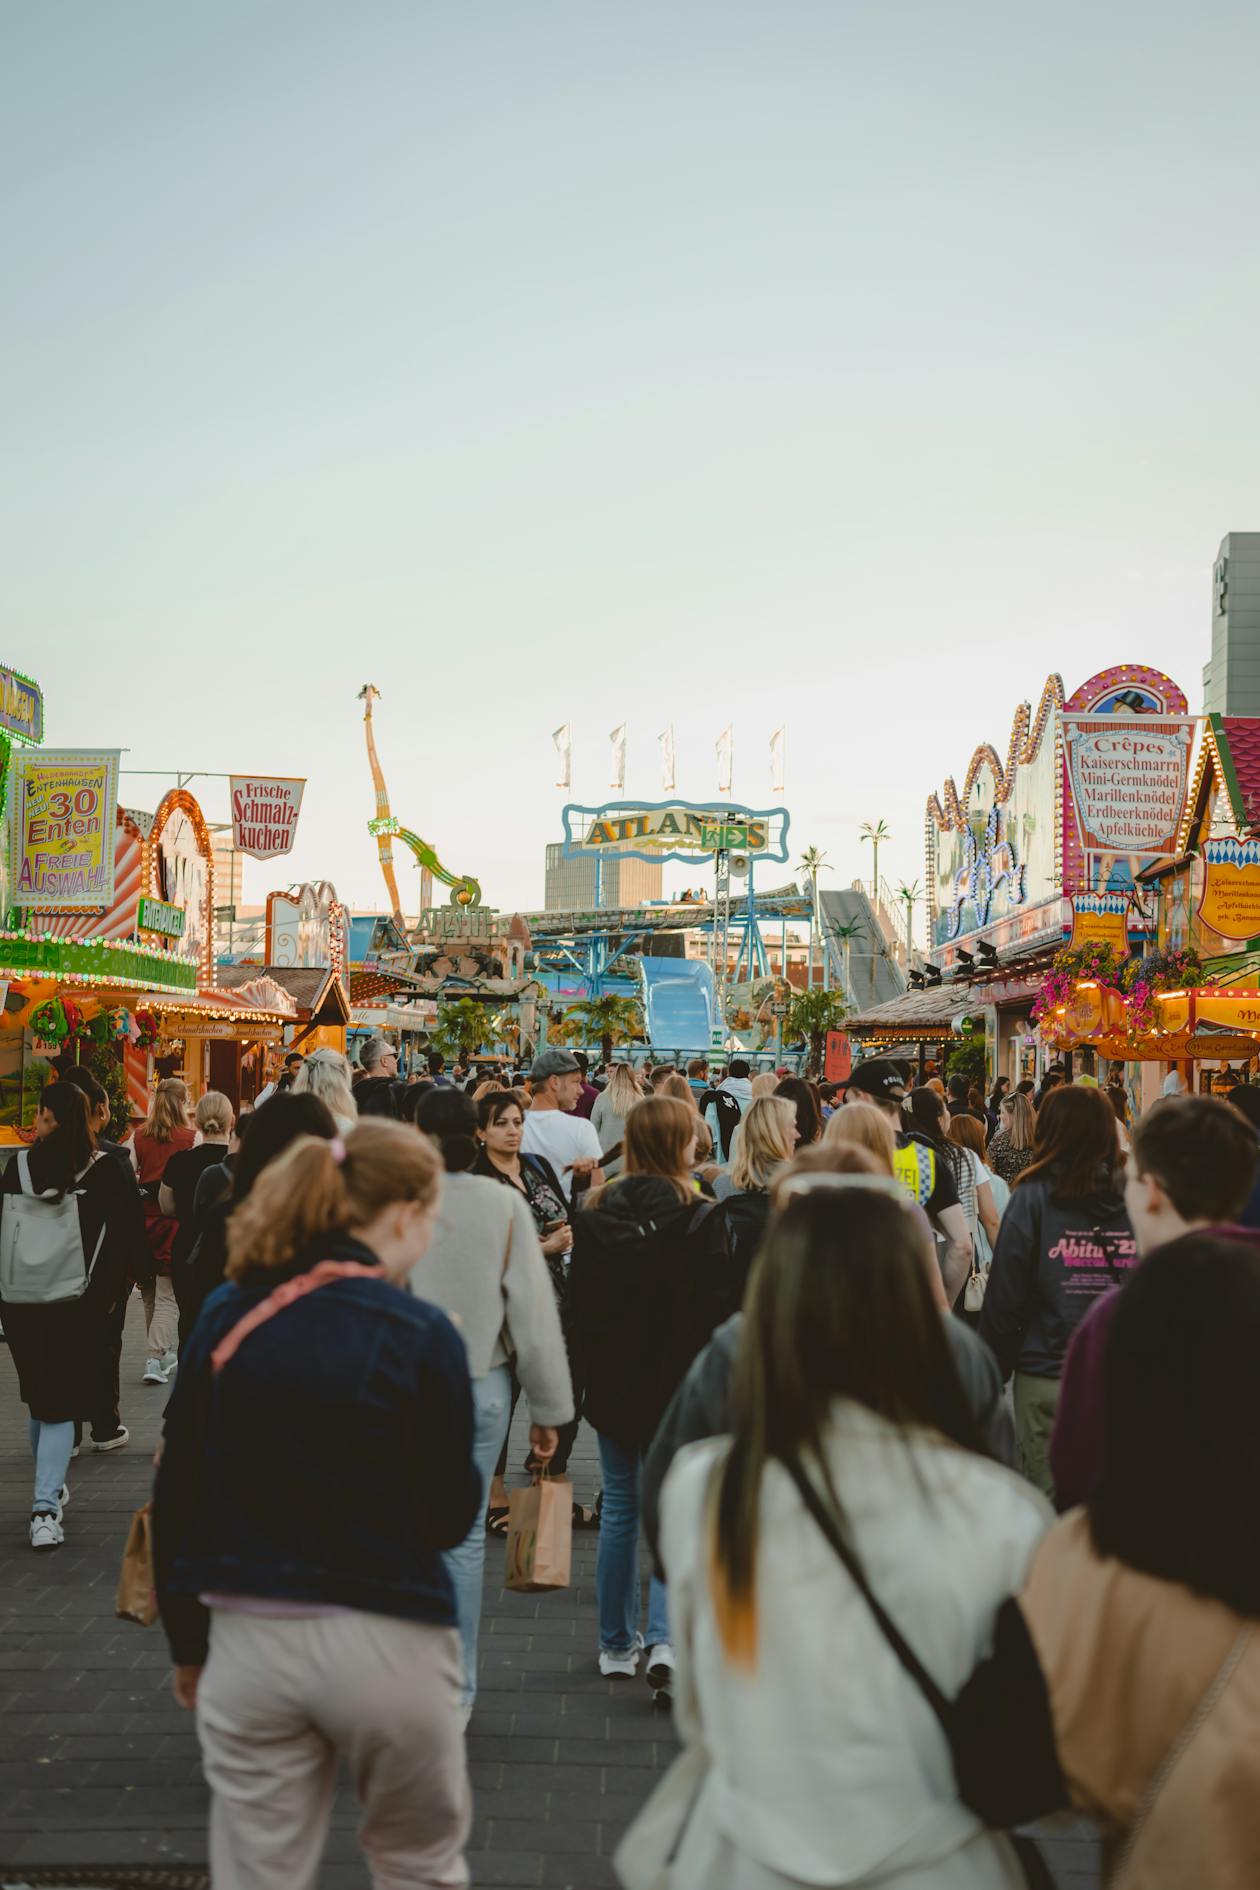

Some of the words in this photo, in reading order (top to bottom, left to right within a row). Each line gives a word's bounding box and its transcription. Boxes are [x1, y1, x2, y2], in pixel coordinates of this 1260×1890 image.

[1093, 737, 1166, 755] Crêpes
[1080, 755, 1180, 772] Kaiserschmarrn
[26, 776, 104, 797] ENTENHAUSEN
[1080, 771, 1179, 788] Mini-Germknödel
[246, 783, 291, 801] Frische
[1084, 788, 1176, 805] Marillenknödel
[48, 788, 98, 821] 30
[233, 789, 298, 825] Schmalz-
[1087, 804, 1174, 822] Erdbeerknödel
[28, 816, 100, 846] Enten
[239, 824, 290, 851] kuchen
[587, 812, 766, 849] ATLANS
[1098, 822, 1165, 839] Apfelküchle
[34, 853, 92, 870] FREIE
[17, 857, 108, 897] AUSWAHL
